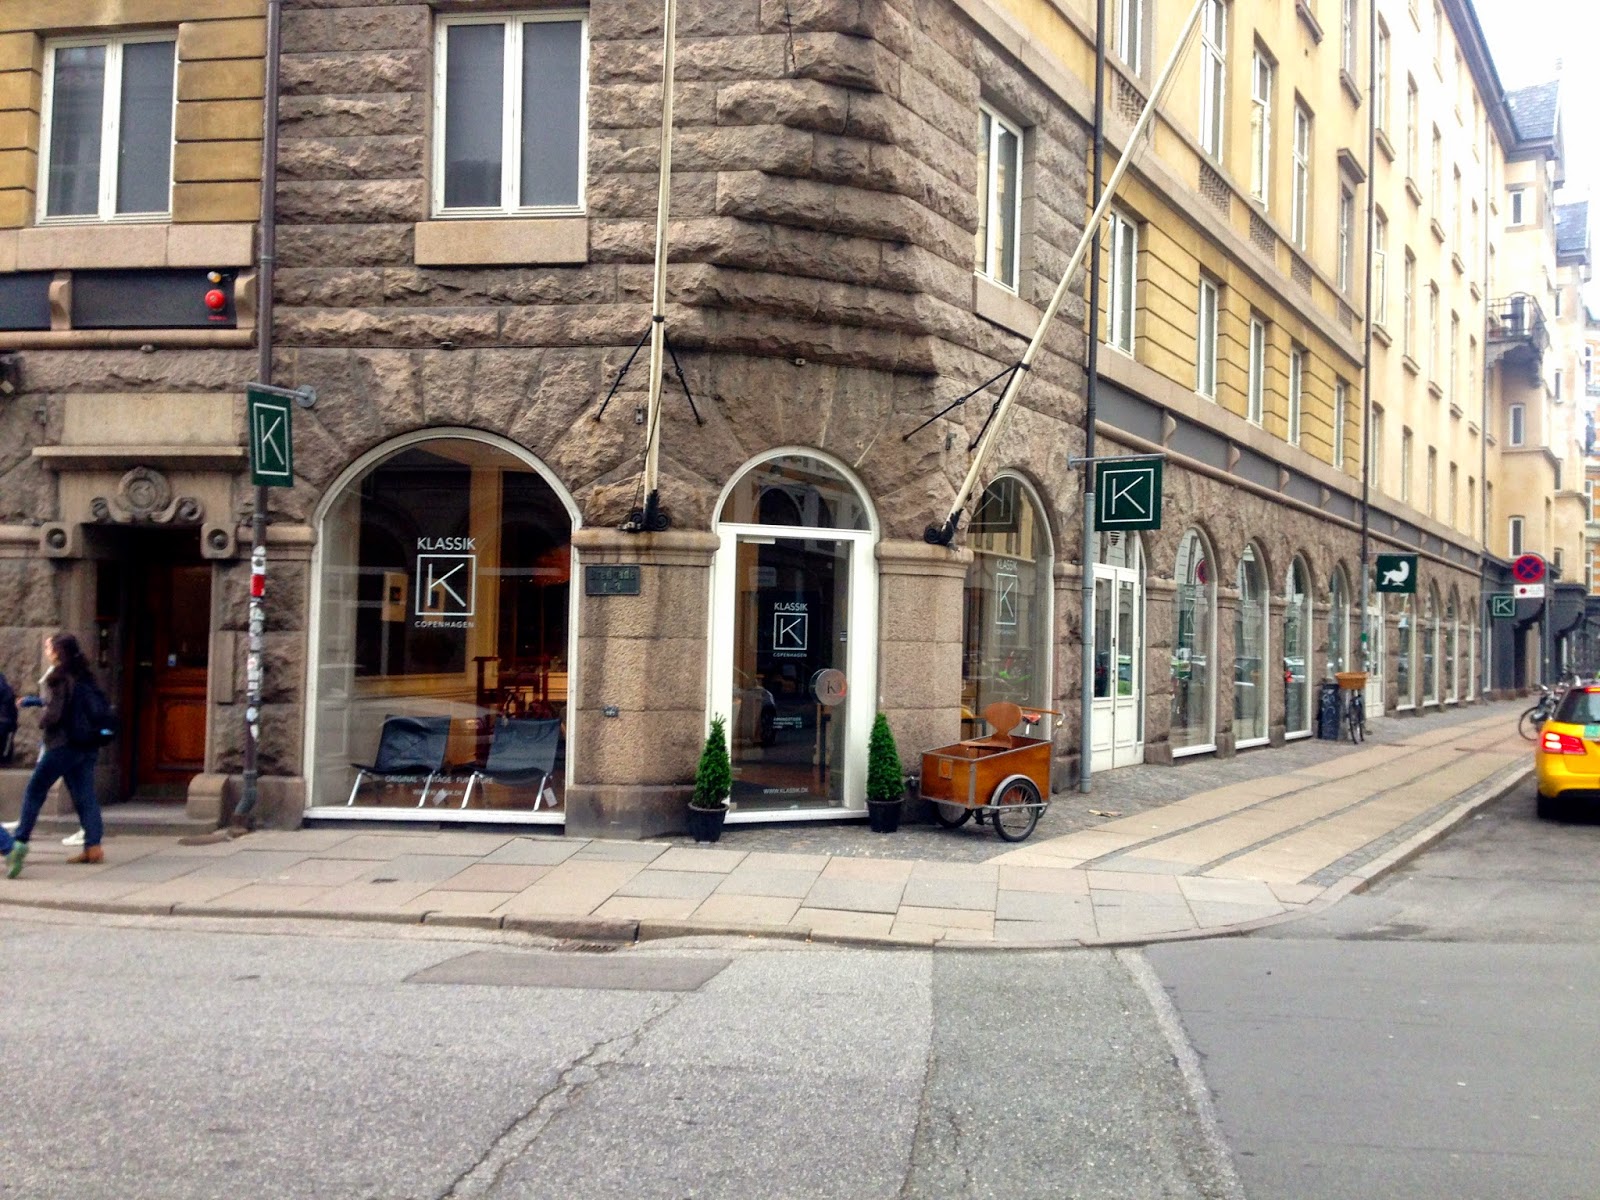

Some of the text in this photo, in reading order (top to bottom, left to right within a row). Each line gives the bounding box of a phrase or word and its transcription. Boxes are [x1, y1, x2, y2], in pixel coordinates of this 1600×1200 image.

[260, 413, 285, 466] K
[1111, 475, 1146, 515] K
[417, 537, 476, 550] KLASSIK
[427, 563, 466, 607] K
[774, 602, 808, 611] KLASSIK
[999, 581, 1014, 618] K
[1496, 599, 1512, 613] K
[414, 620, 475, 628] COPENHAGEN
[780, 618, 803, 645] K
